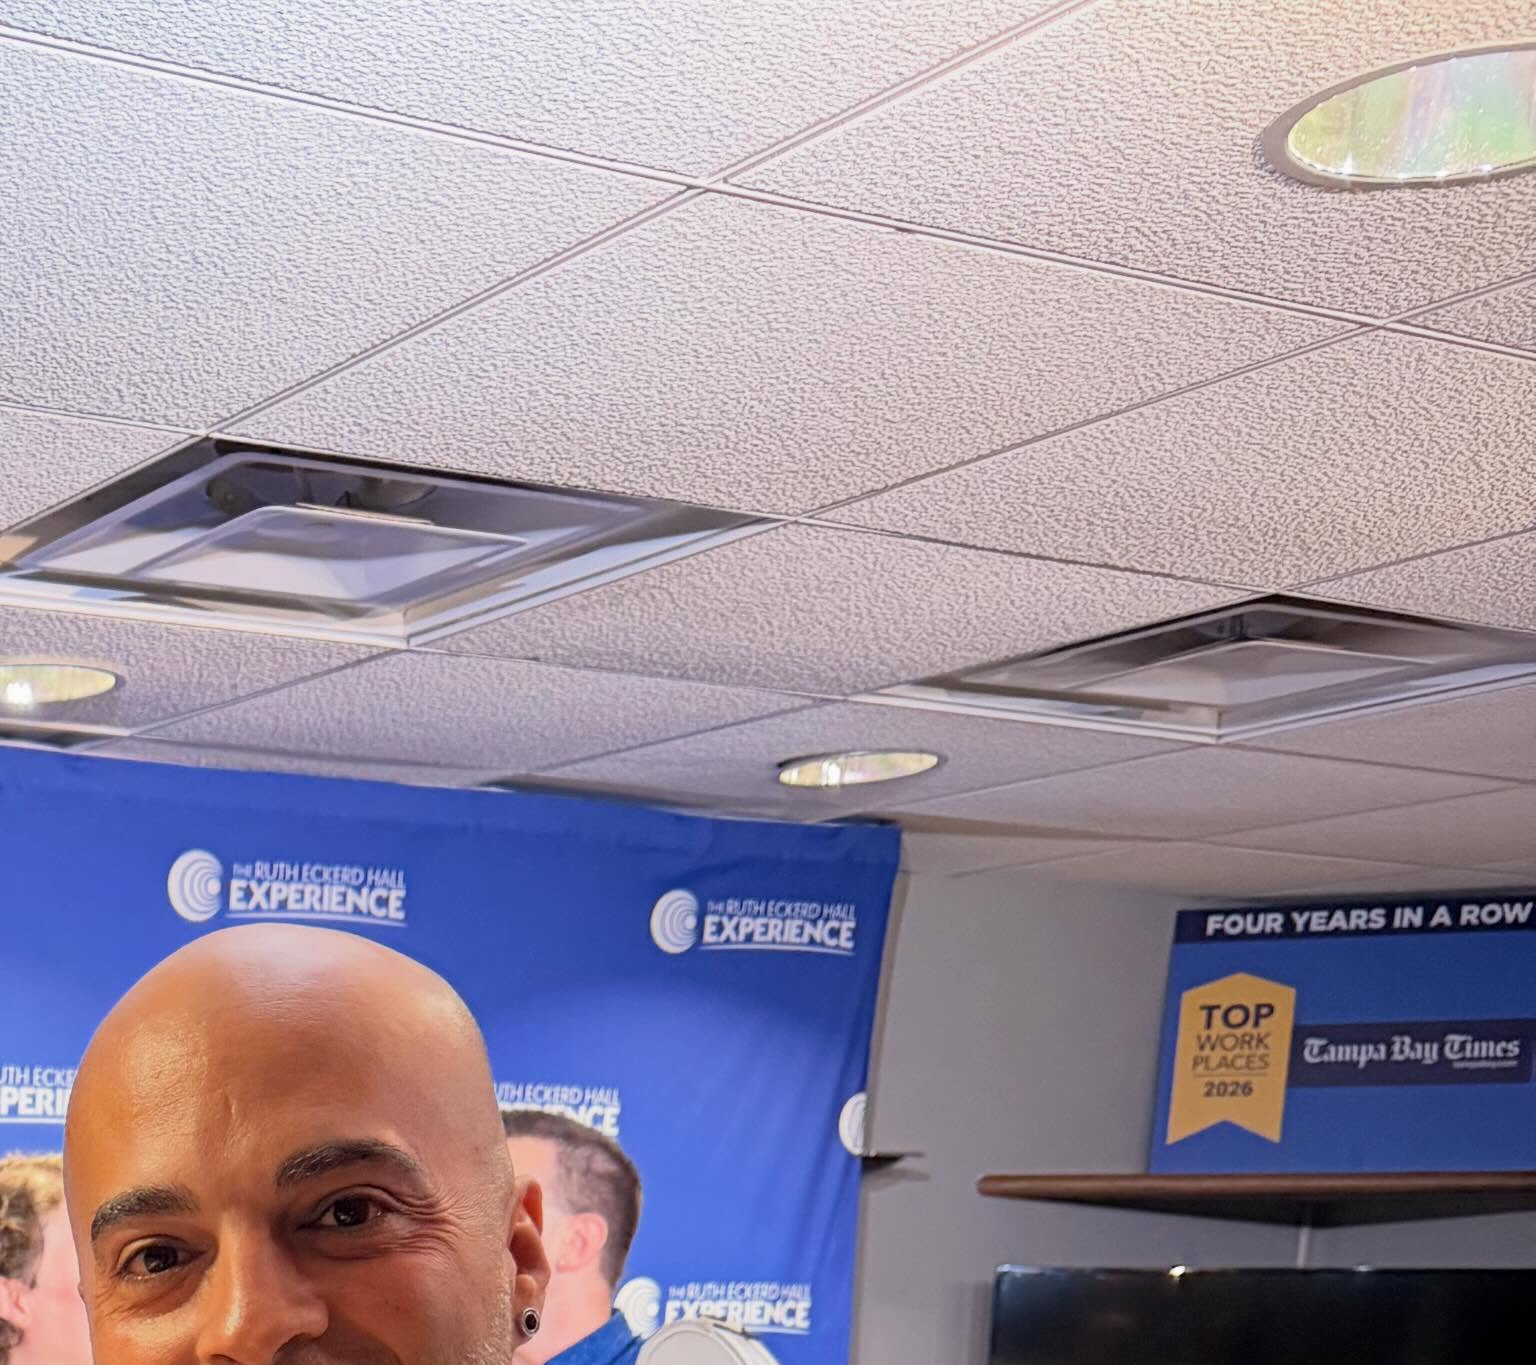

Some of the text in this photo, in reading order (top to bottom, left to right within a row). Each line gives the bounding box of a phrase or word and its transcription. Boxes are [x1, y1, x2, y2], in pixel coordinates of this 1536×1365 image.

[255, 861, 299, 881] RUTH
[302, 862, 364, 885] ECKERD
[366, 868, 405, 889] HALL
[229, 878, 406, 920] EXPERIENCE
[726, 898, 765, 916] RUTH
[822, 903, 856, 921] HALL
[702, 915, 856, 949] EXPERIENCE
[1206, 902, 1534, 936] FOUR YEARS IN A ROW
[1200, 1004, 1274, 1030] TOP
[1196, 1033, 1270, 1051] WORK
[1303, 1034, 1520, 1069] Tampa Bay Times
[1192, 1054, 1269, 1071] PLACES
[525, 1082, 582, 1105] ECKERD
[584, 1087, 619, 1106] HALL
[686, 1281, 726, 1299] RUTH
